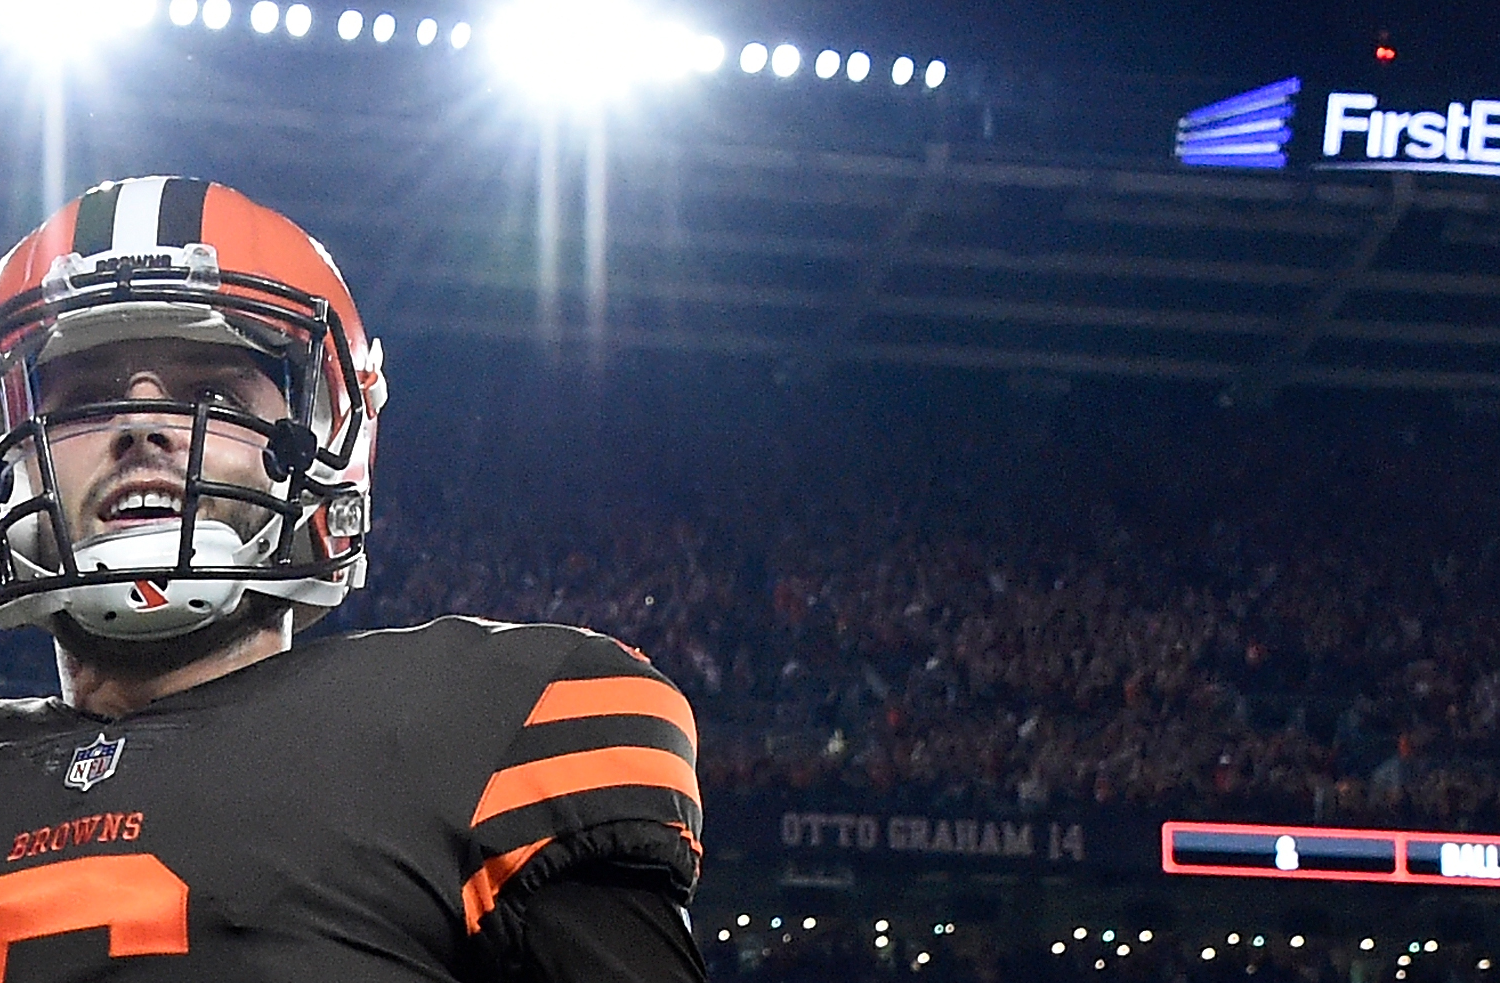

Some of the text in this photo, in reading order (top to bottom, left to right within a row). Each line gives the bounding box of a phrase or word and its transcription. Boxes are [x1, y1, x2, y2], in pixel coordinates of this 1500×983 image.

[7, 812, 144, 861] BROWNS
[783, 813, 1084, 861] OTTO GRAHAM 14
